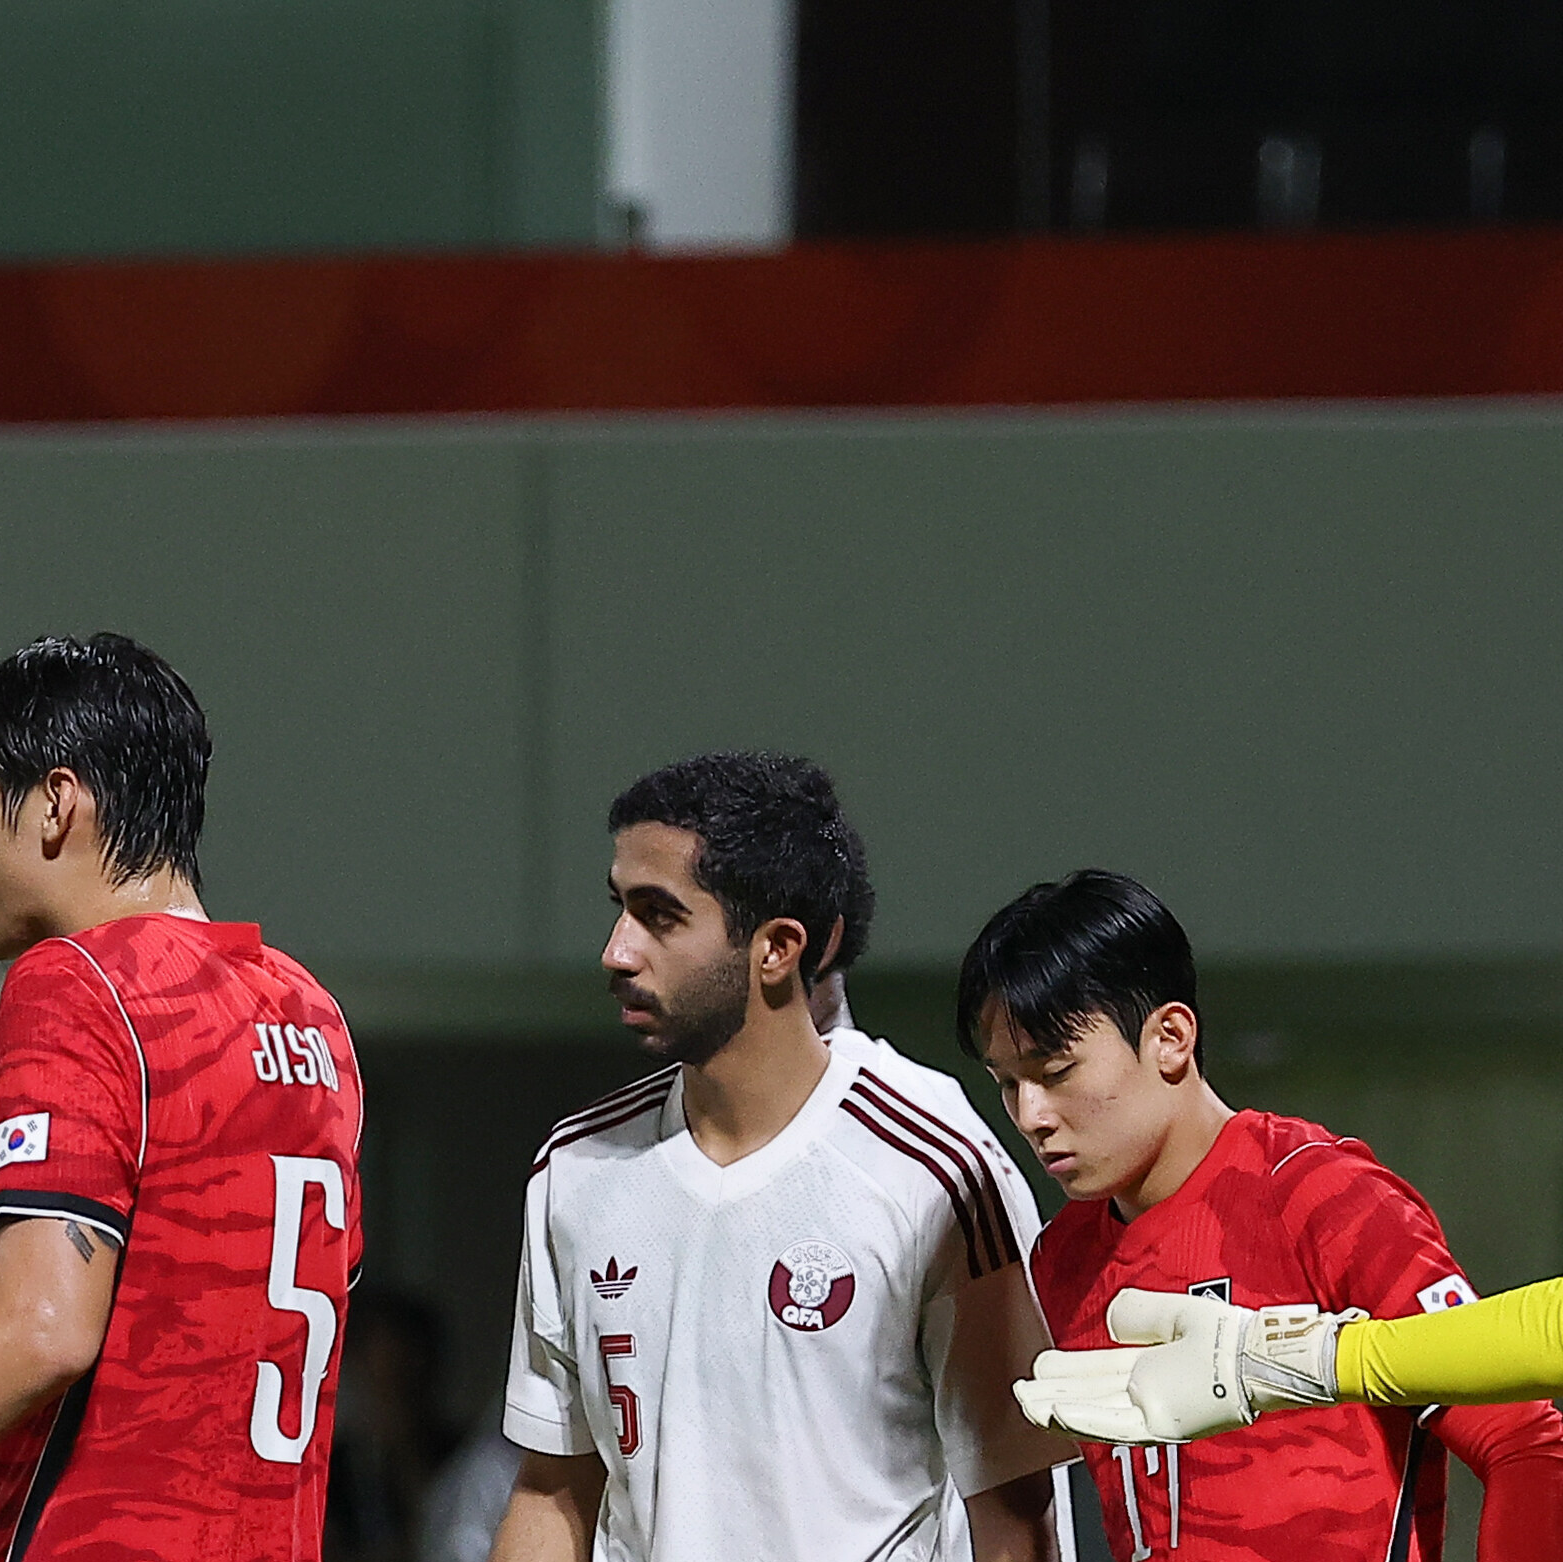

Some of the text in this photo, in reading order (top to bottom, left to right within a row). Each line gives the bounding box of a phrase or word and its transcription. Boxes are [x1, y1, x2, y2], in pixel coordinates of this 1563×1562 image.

[250, 1154, 345, 1464] 5
[781, 1303, 825, 1330] QFA
[599, 1333, 642, 1460] 5
